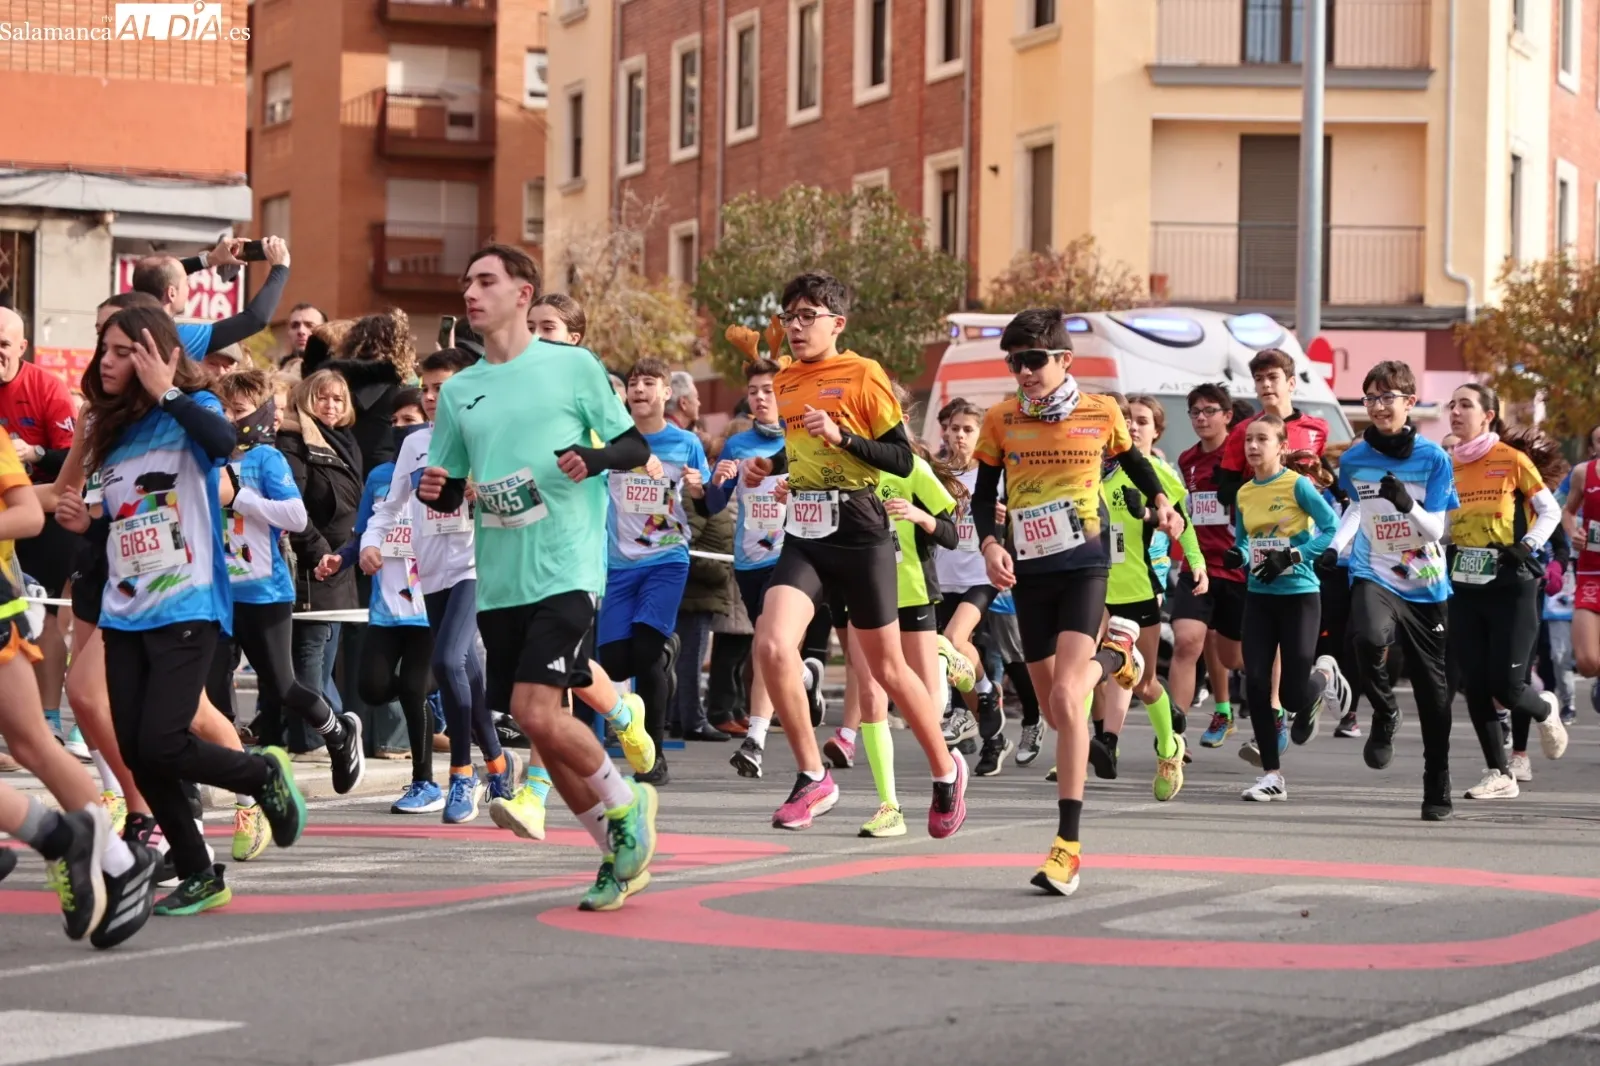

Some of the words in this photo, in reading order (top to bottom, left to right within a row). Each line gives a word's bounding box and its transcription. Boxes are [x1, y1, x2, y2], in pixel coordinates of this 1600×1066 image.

[1020, 450, 1060, 458] ESCUELA
[626, 486, 658, 502] 6226
[752, 503, 778, 518] 6155
[794, 503, 823, 522] 6221
[1195, 500, 1217, 514] 6149
[125, 512, 169, 531] SETEL
[1023, 516, 1058, 542] 6151
[1376, 521, 1411, 540] 6225
[120, 527, 160, 558] 6183
